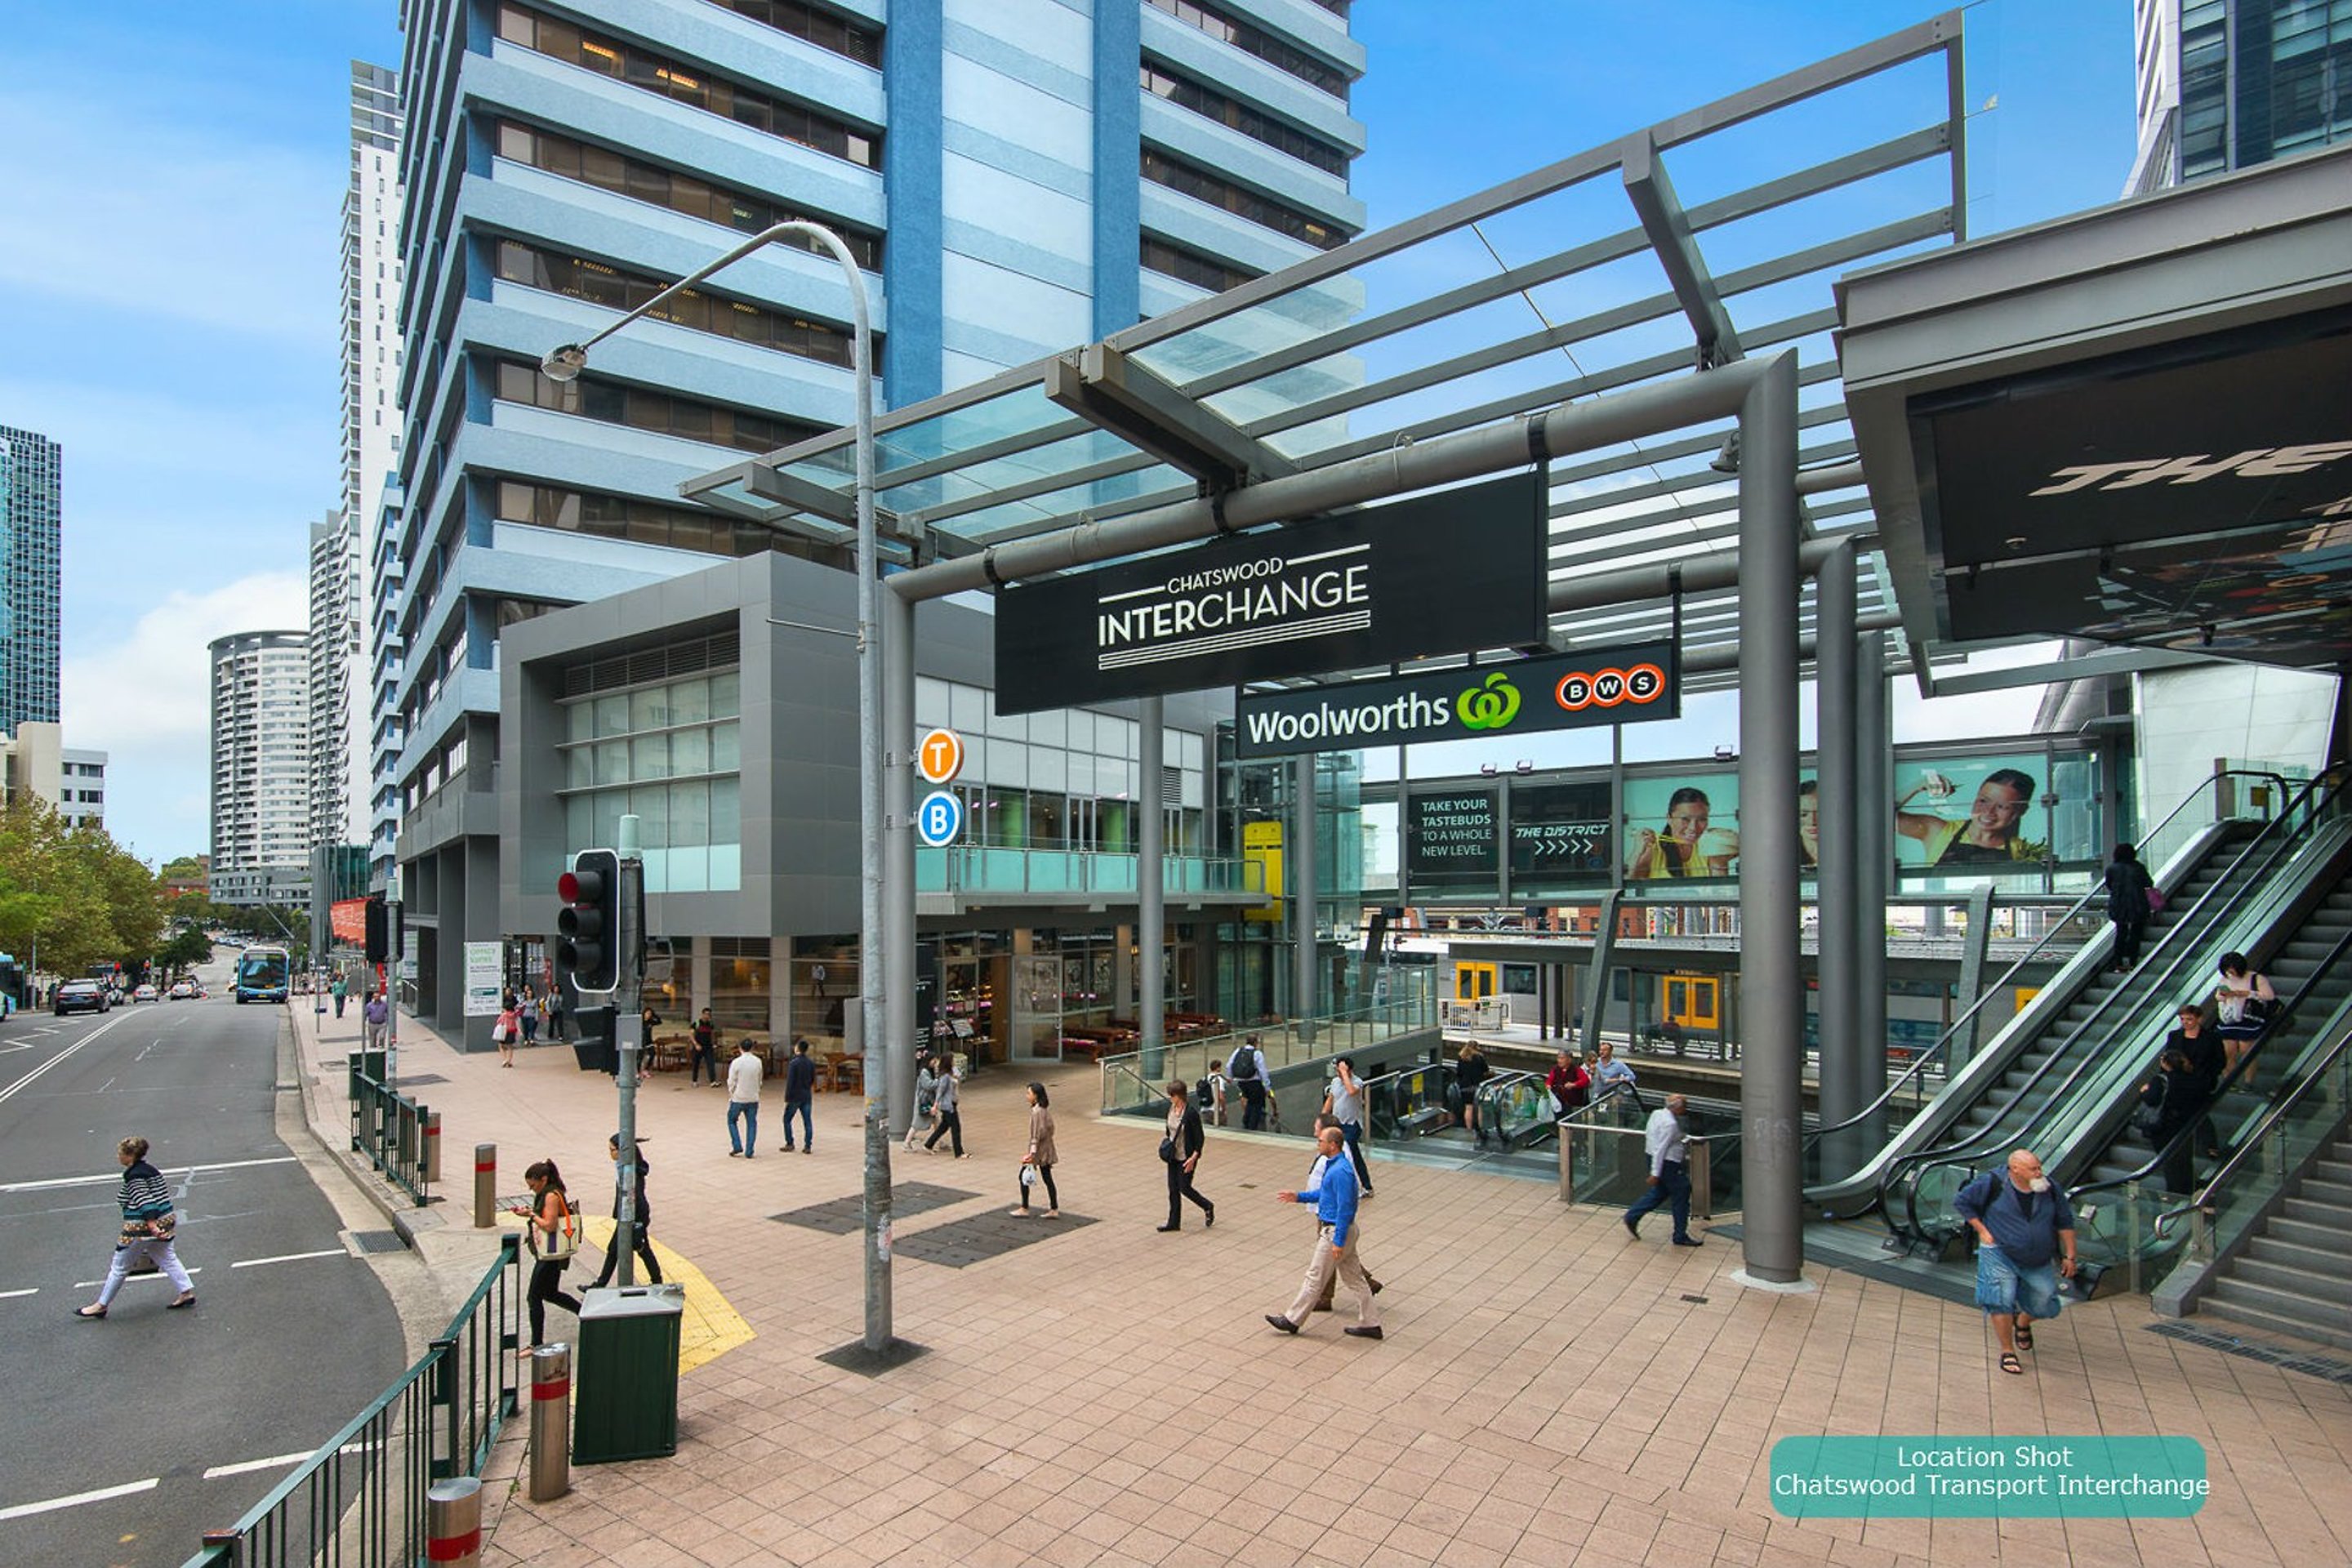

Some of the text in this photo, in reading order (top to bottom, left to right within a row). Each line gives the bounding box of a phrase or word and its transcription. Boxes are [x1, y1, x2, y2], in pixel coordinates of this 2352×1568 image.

[1168, 557, 1283, 594] CHATSWOOD
[1098, 564, 1370, 647] INTERCHANGE
[1248, 692, 1450, 744] Woolworths
[929, 742, 947, 773] T
[1422, 799, 1488, 812] TAKE YOUR
[930, 804, 948, 835] B
[1422, 813, 1491, 827] TASTEBUDS
[1516, 823, 1610, 838] THE DISTRICT
[1422, 828, 1492, 841] TO A WHOLE
[1422, 844, 1487, 858] NEW LEVEL.
